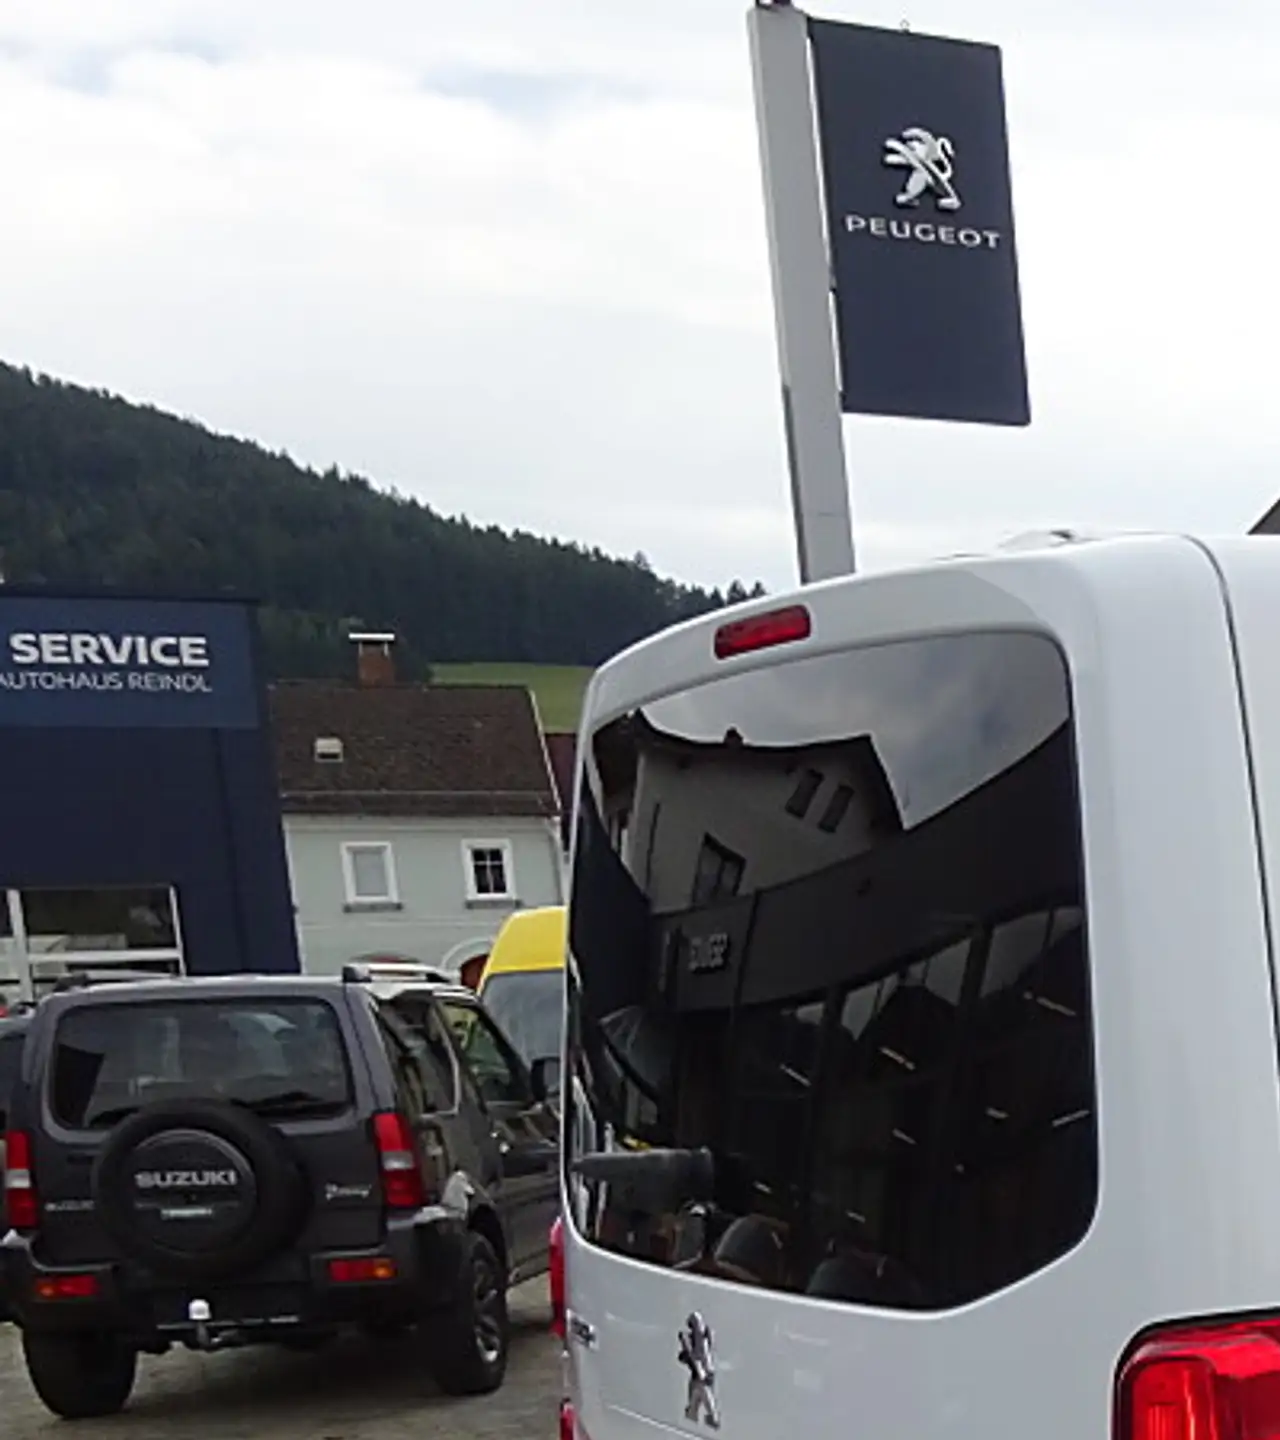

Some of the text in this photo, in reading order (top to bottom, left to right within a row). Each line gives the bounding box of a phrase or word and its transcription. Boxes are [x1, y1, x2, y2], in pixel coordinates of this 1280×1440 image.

[845, 214, 1000, 248] PEUGEOT
[9, 633, 210, 666] SERVICE
[128, 673, 213, 692] REINDL
